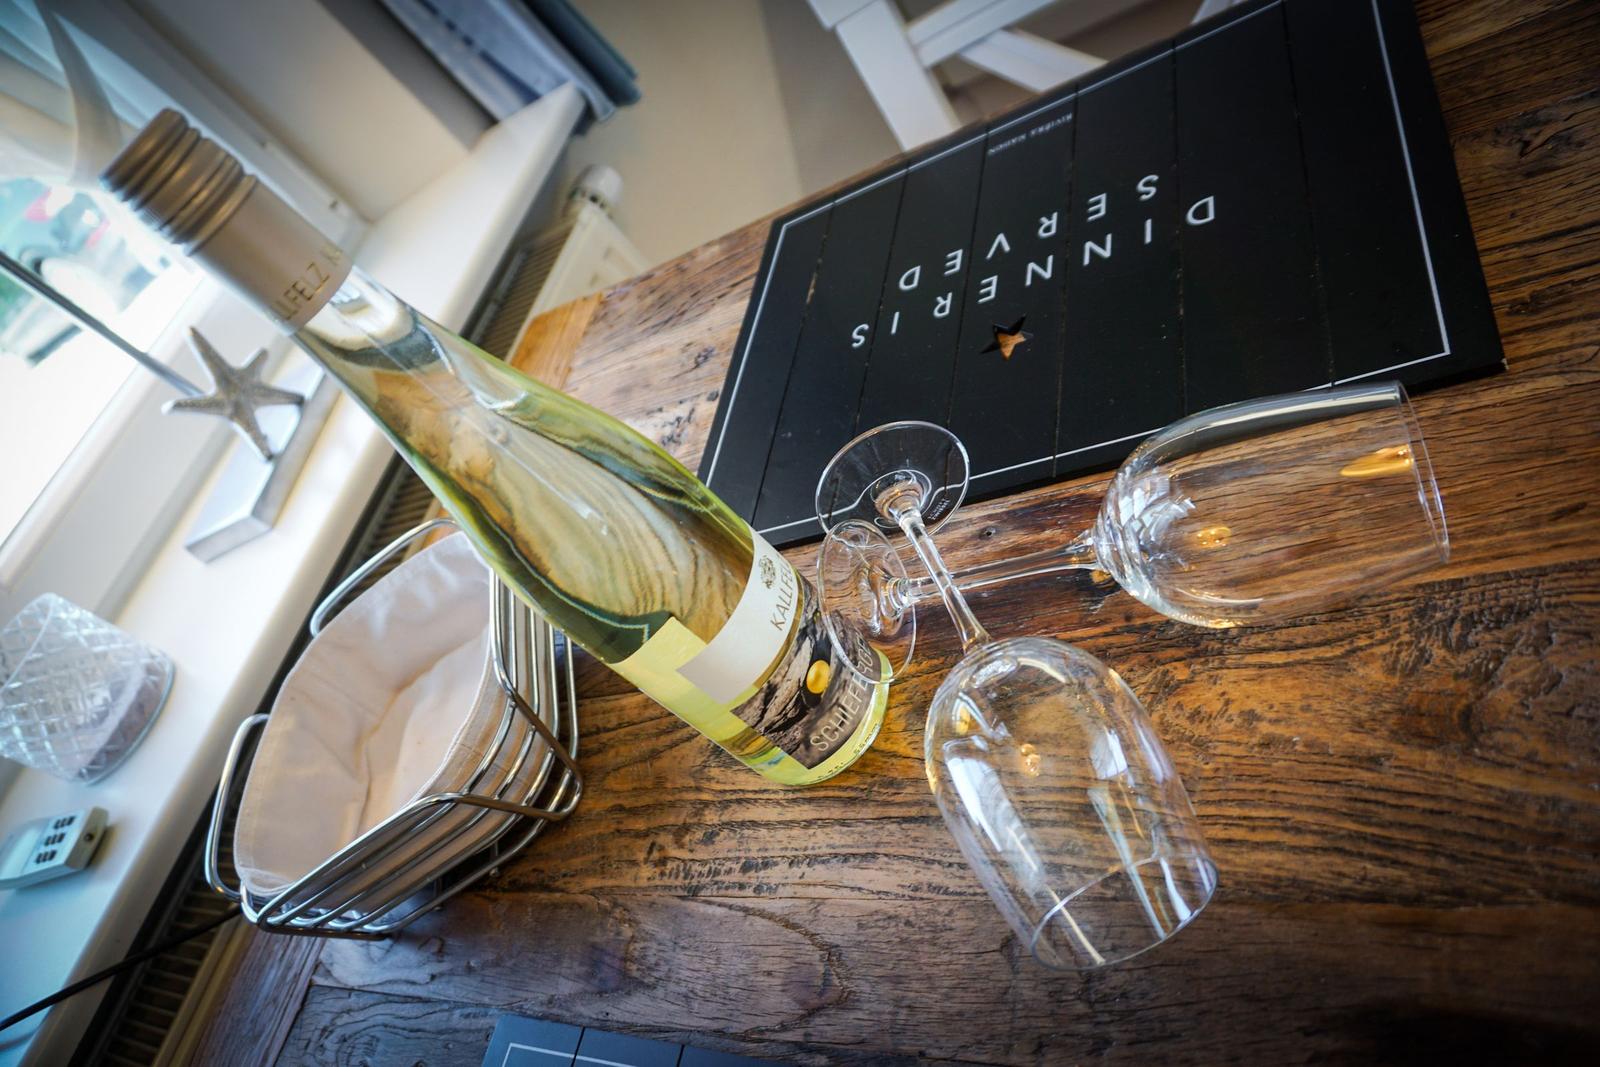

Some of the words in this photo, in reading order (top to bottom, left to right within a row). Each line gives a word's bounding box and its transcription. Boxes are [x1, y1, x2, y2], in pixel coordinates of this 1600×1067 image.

[899, 174, 1160, 292] SERVED
[933, 196, 1216, 319] DINNER
[852, 311, 900, 348] IS
